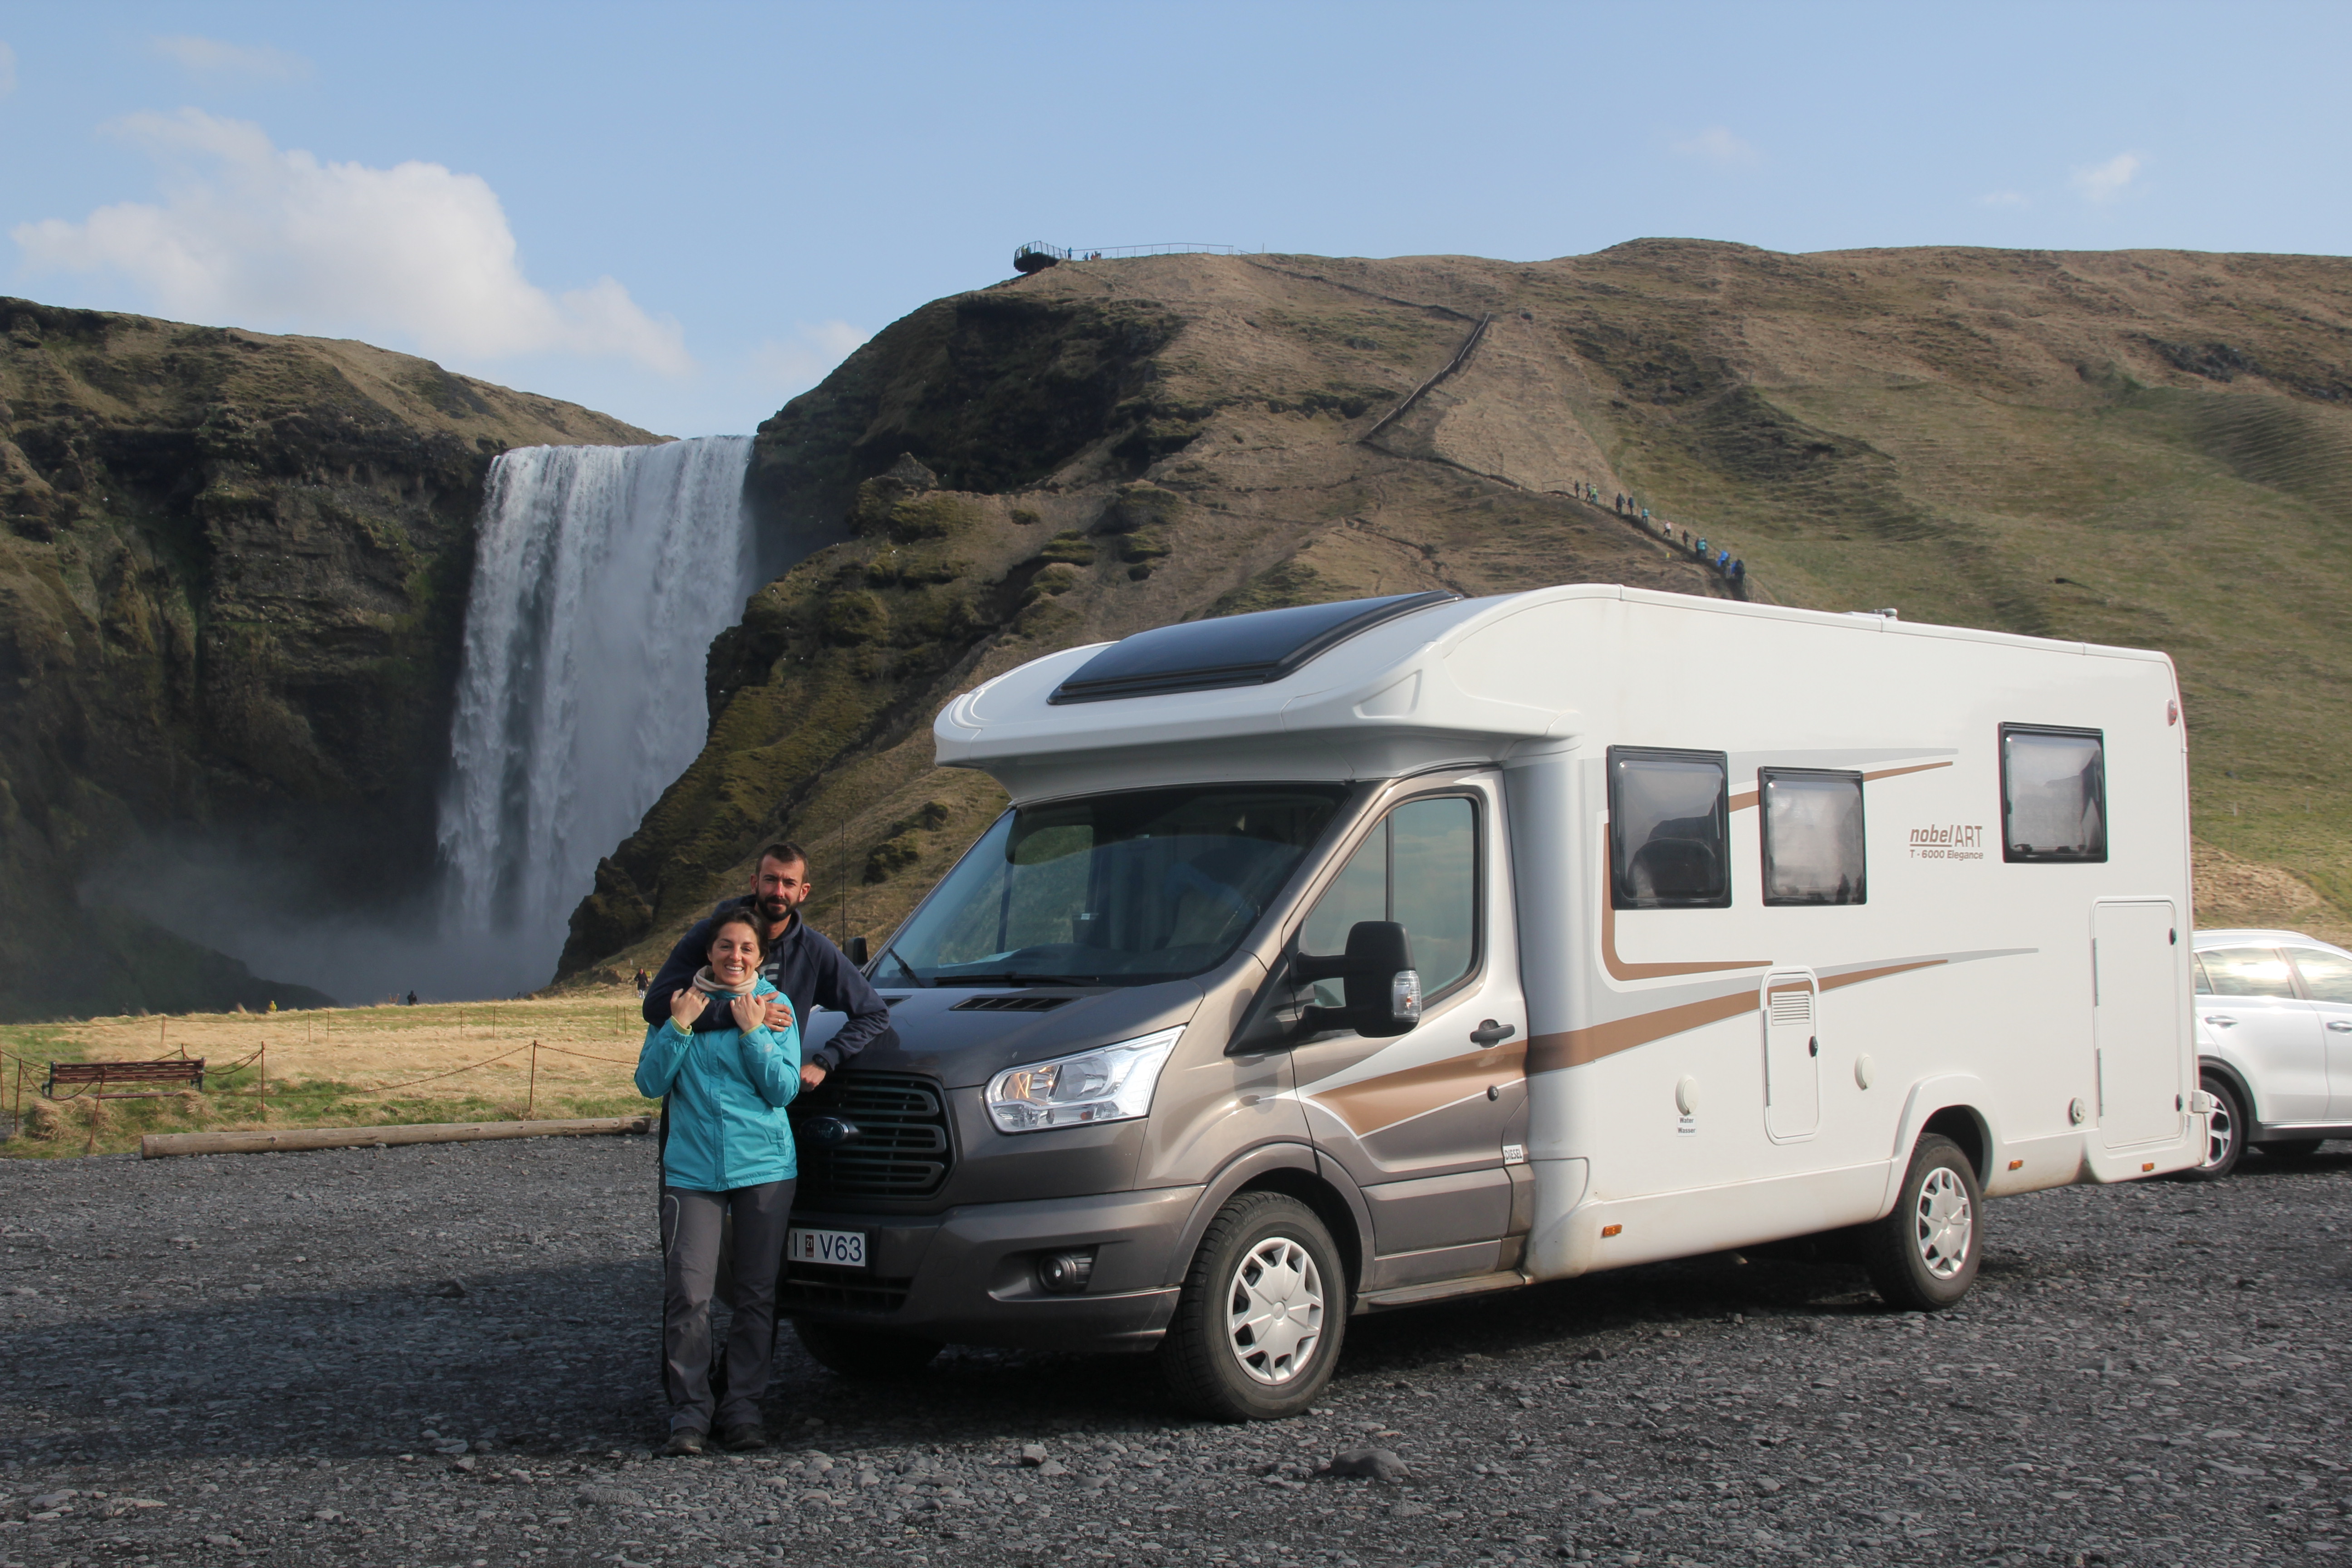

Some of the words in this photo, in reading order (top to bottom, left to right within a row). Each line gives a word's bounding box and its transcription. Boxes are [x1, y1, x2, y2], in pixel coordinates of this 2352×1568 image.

[1910, 849, 1915, 858] T
[1922, 850, 1945, 859] 6000
[1947, 850, 1984, 861] Elegance
[1504, 1148, 1522, 1160] DIESEL
[806, 1238, 813, 1248] 21
[819, 1234, 862, 1262] V63
